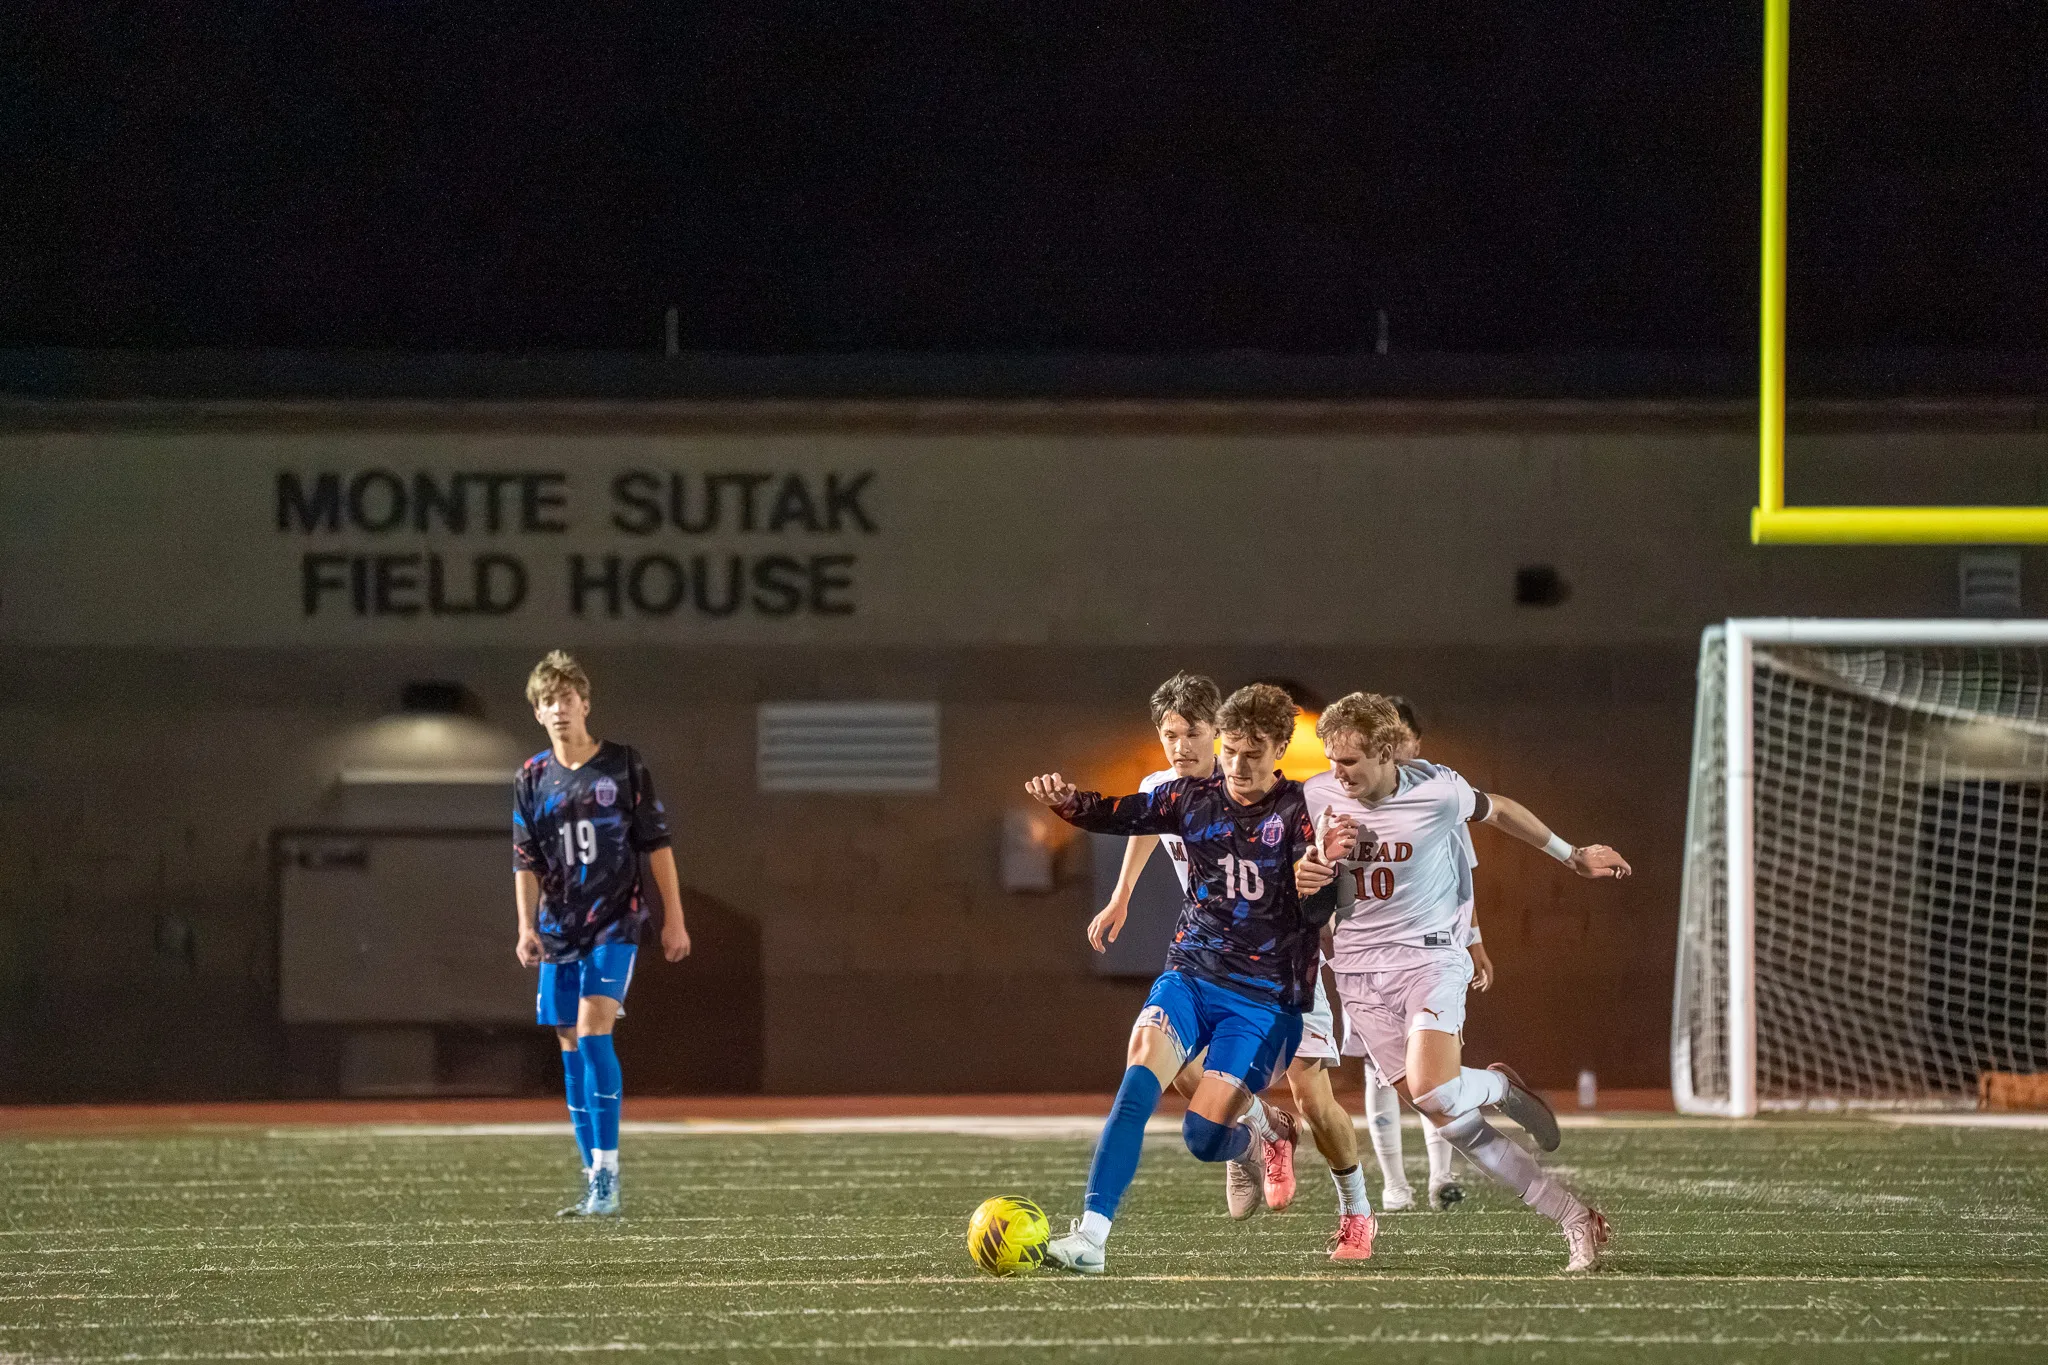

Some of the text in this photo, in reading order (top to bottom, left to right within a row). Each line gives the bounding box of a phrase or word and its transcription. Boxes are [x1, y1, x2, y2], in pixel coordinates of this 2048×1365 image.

[276, 469, 879, 534] MONTE SUTAK
[303, 552, 857, 618] FIELD HOUSE
[559, 820, 597, 866] 19
[1217, 853, 1265, 901] 10
[1349, 867, 1395, 900] 10
